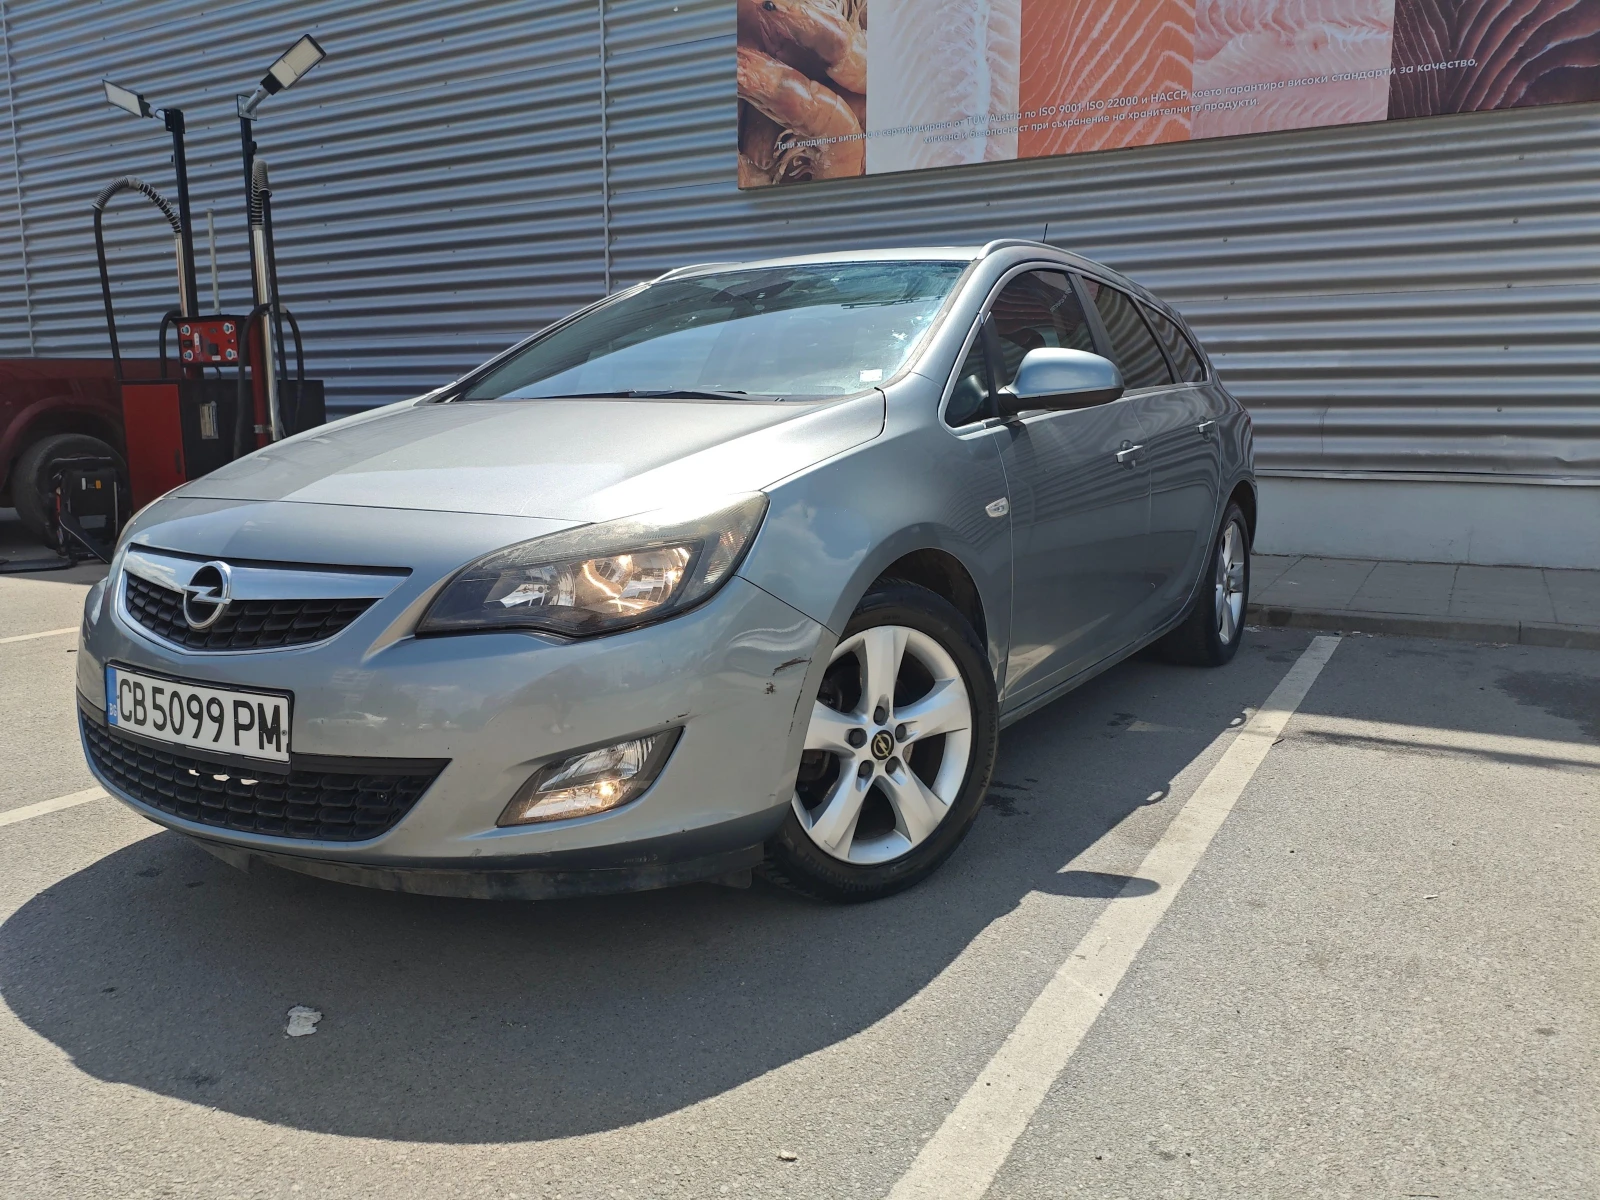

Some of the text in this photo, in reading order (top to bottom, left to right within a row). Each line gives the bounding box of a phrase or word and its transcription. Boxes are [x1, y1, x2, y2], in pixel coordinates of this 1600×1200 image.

[796, 136, 837, 147] хладилна
[838, 131, 873, 142] витрина
[881, 121, 952, 136] сертифицирана
[989, 112, 1022, 122] Austria
[1039, 106, 1056, 116] ISO
[1059, 102, 1084, 113] 9001,
[1086, 100, 1104, 111] ISO
[1107, 96, 1138, 108] 22000
[1192, 88, 1222, 98] което
[1225, 81, 1285, 95] гарантира
[1287, 75, 1328, 87] високи
[1331, 67, 1396, 82] стандарти
[1400, 65, 1414, 74] за
[1417, 58, 1478, 72] качество,
[923, 134, 959, 144] хигиена
[969, 124, 1028, 139] безопасност
[1031, 122, 1049, 132] при
[1051, 115, 1110, 129] съхранение
[1113, 113, 1125, 121] на
[1127, 105, 1201, 120] хранителните
[1204, 98, 1260, 112] продукти.
[108, 702, 117, 717] BG
